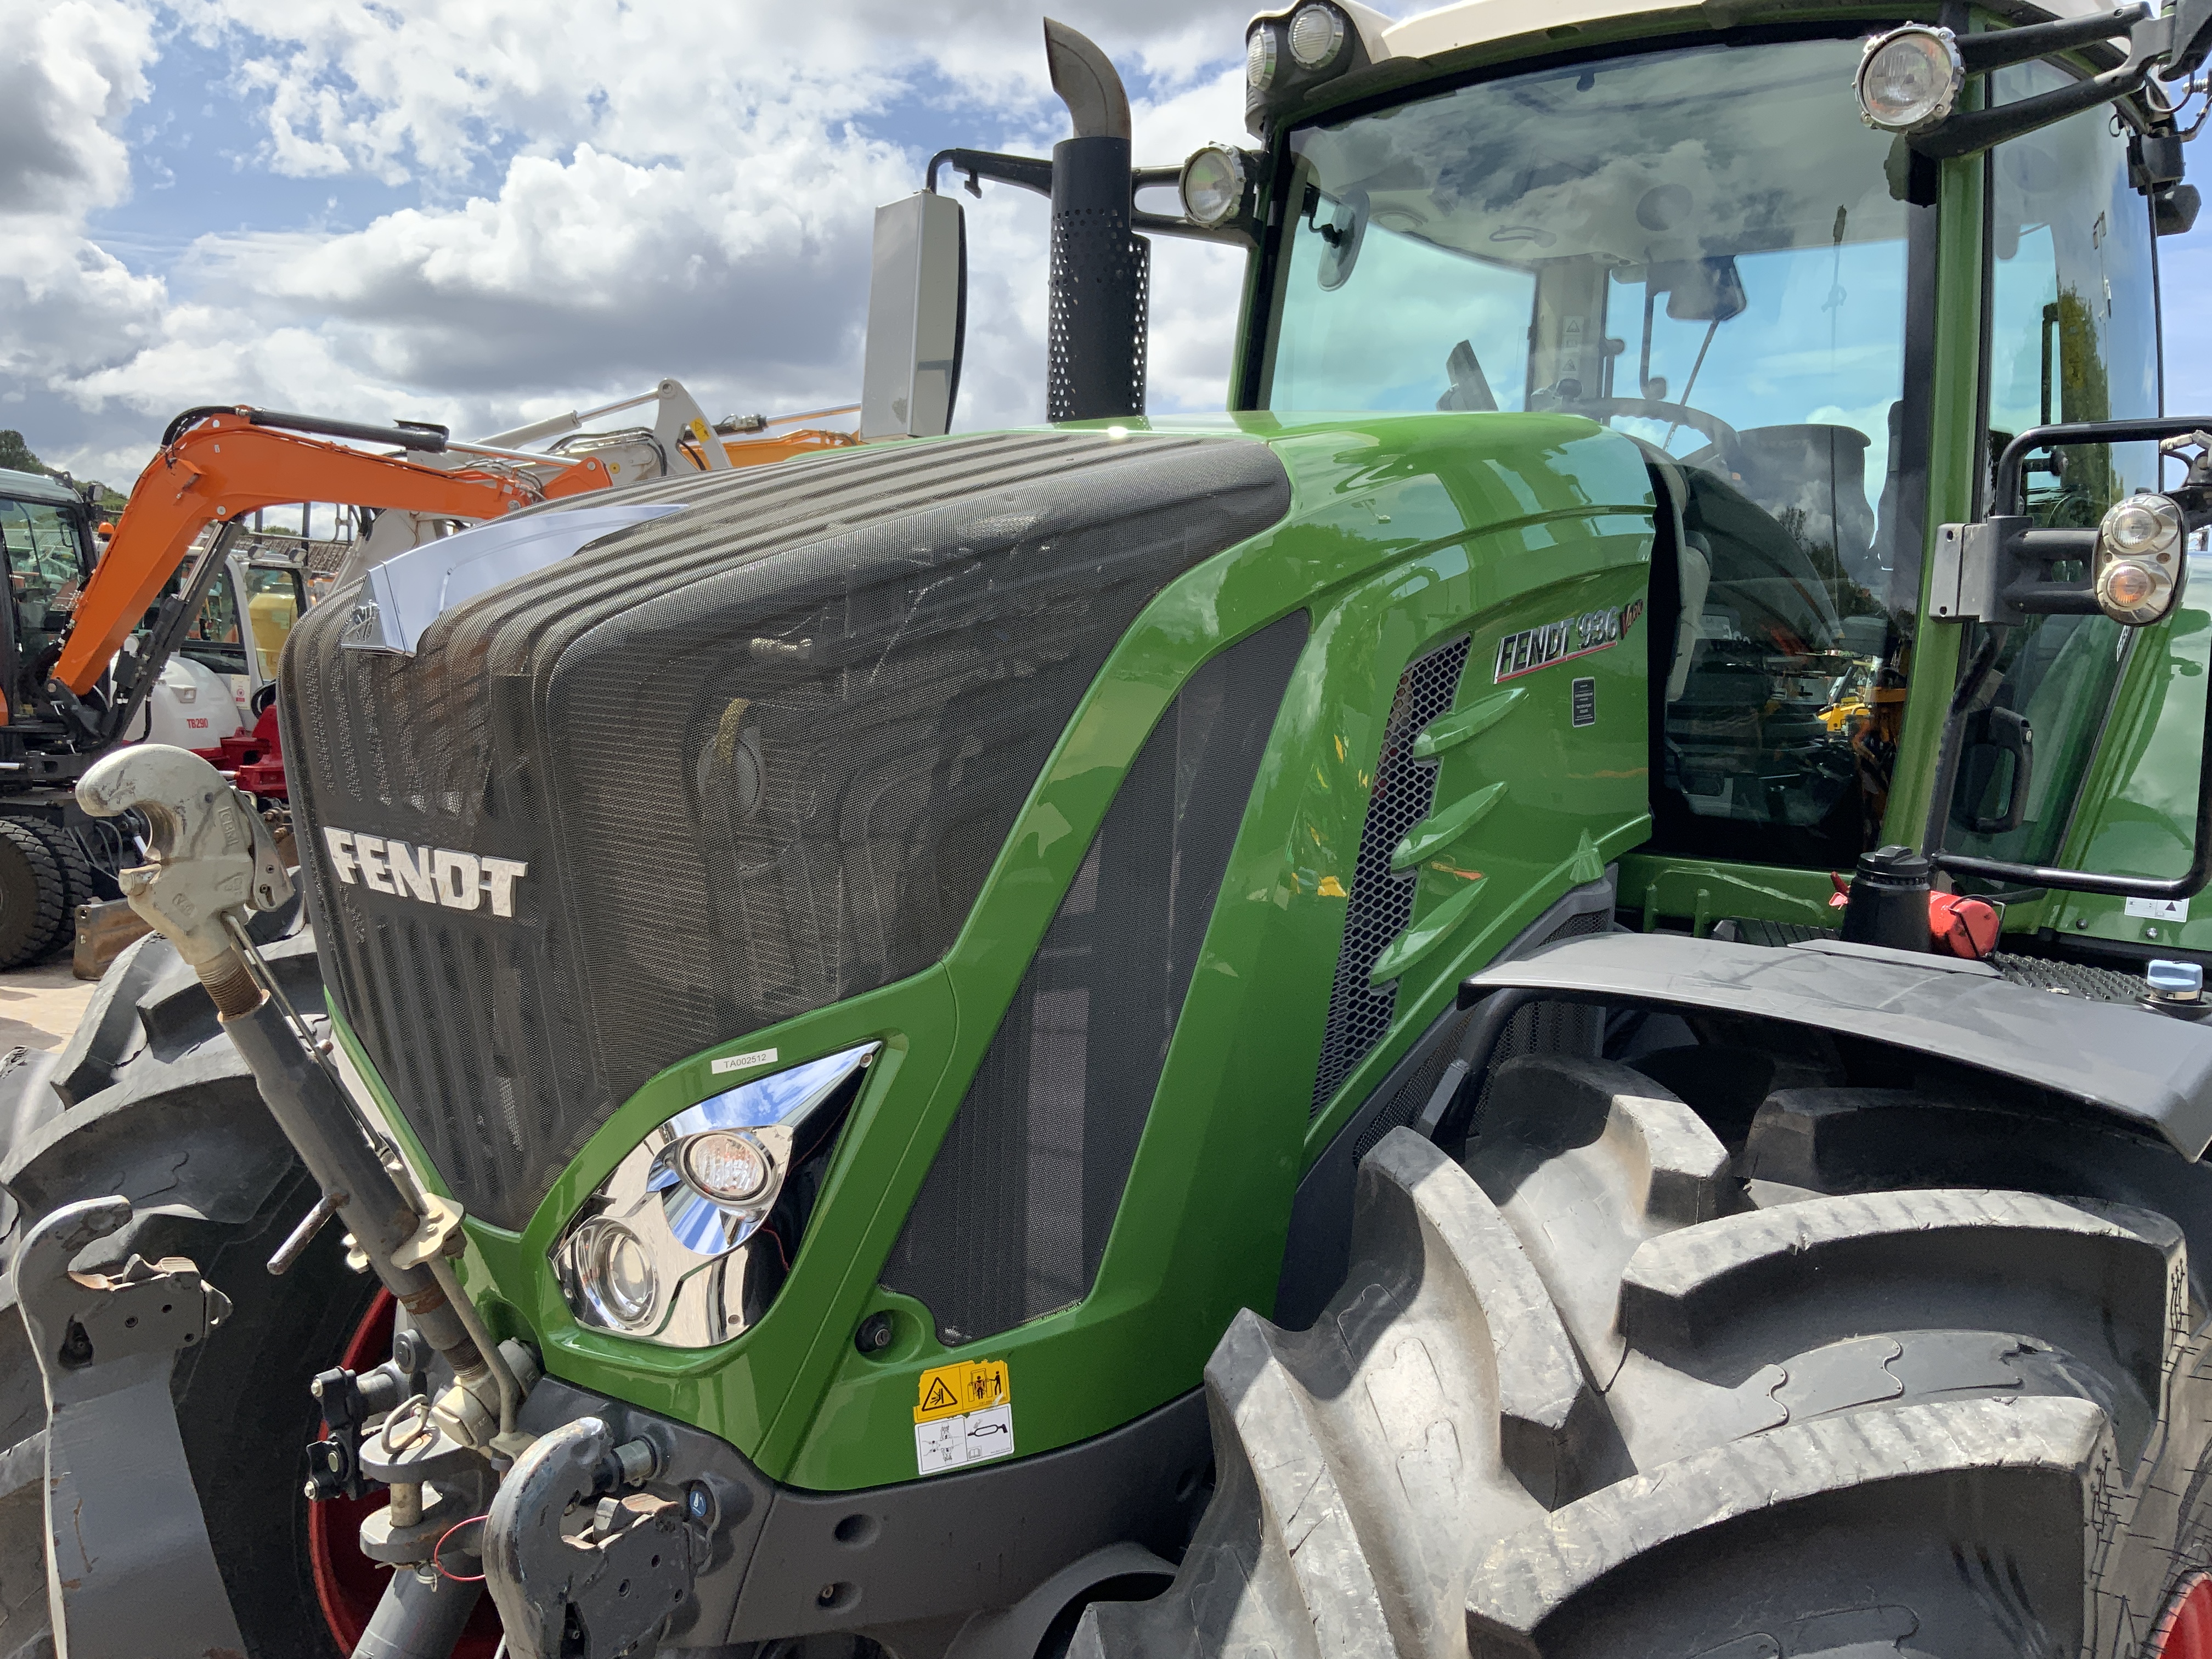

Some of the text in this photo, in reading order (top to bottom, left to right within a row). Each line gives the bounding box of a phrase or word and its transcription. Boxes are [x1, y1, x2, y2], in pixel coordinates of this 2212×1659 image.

[1493, 617, 1575, 684] FENDT
[1576, 606, 1619, 650] 936
[187, 718, 209, 729] TB290
[324, 826, 529, 918] FENDT
[724, 1053, 767, 1069] TA002512
